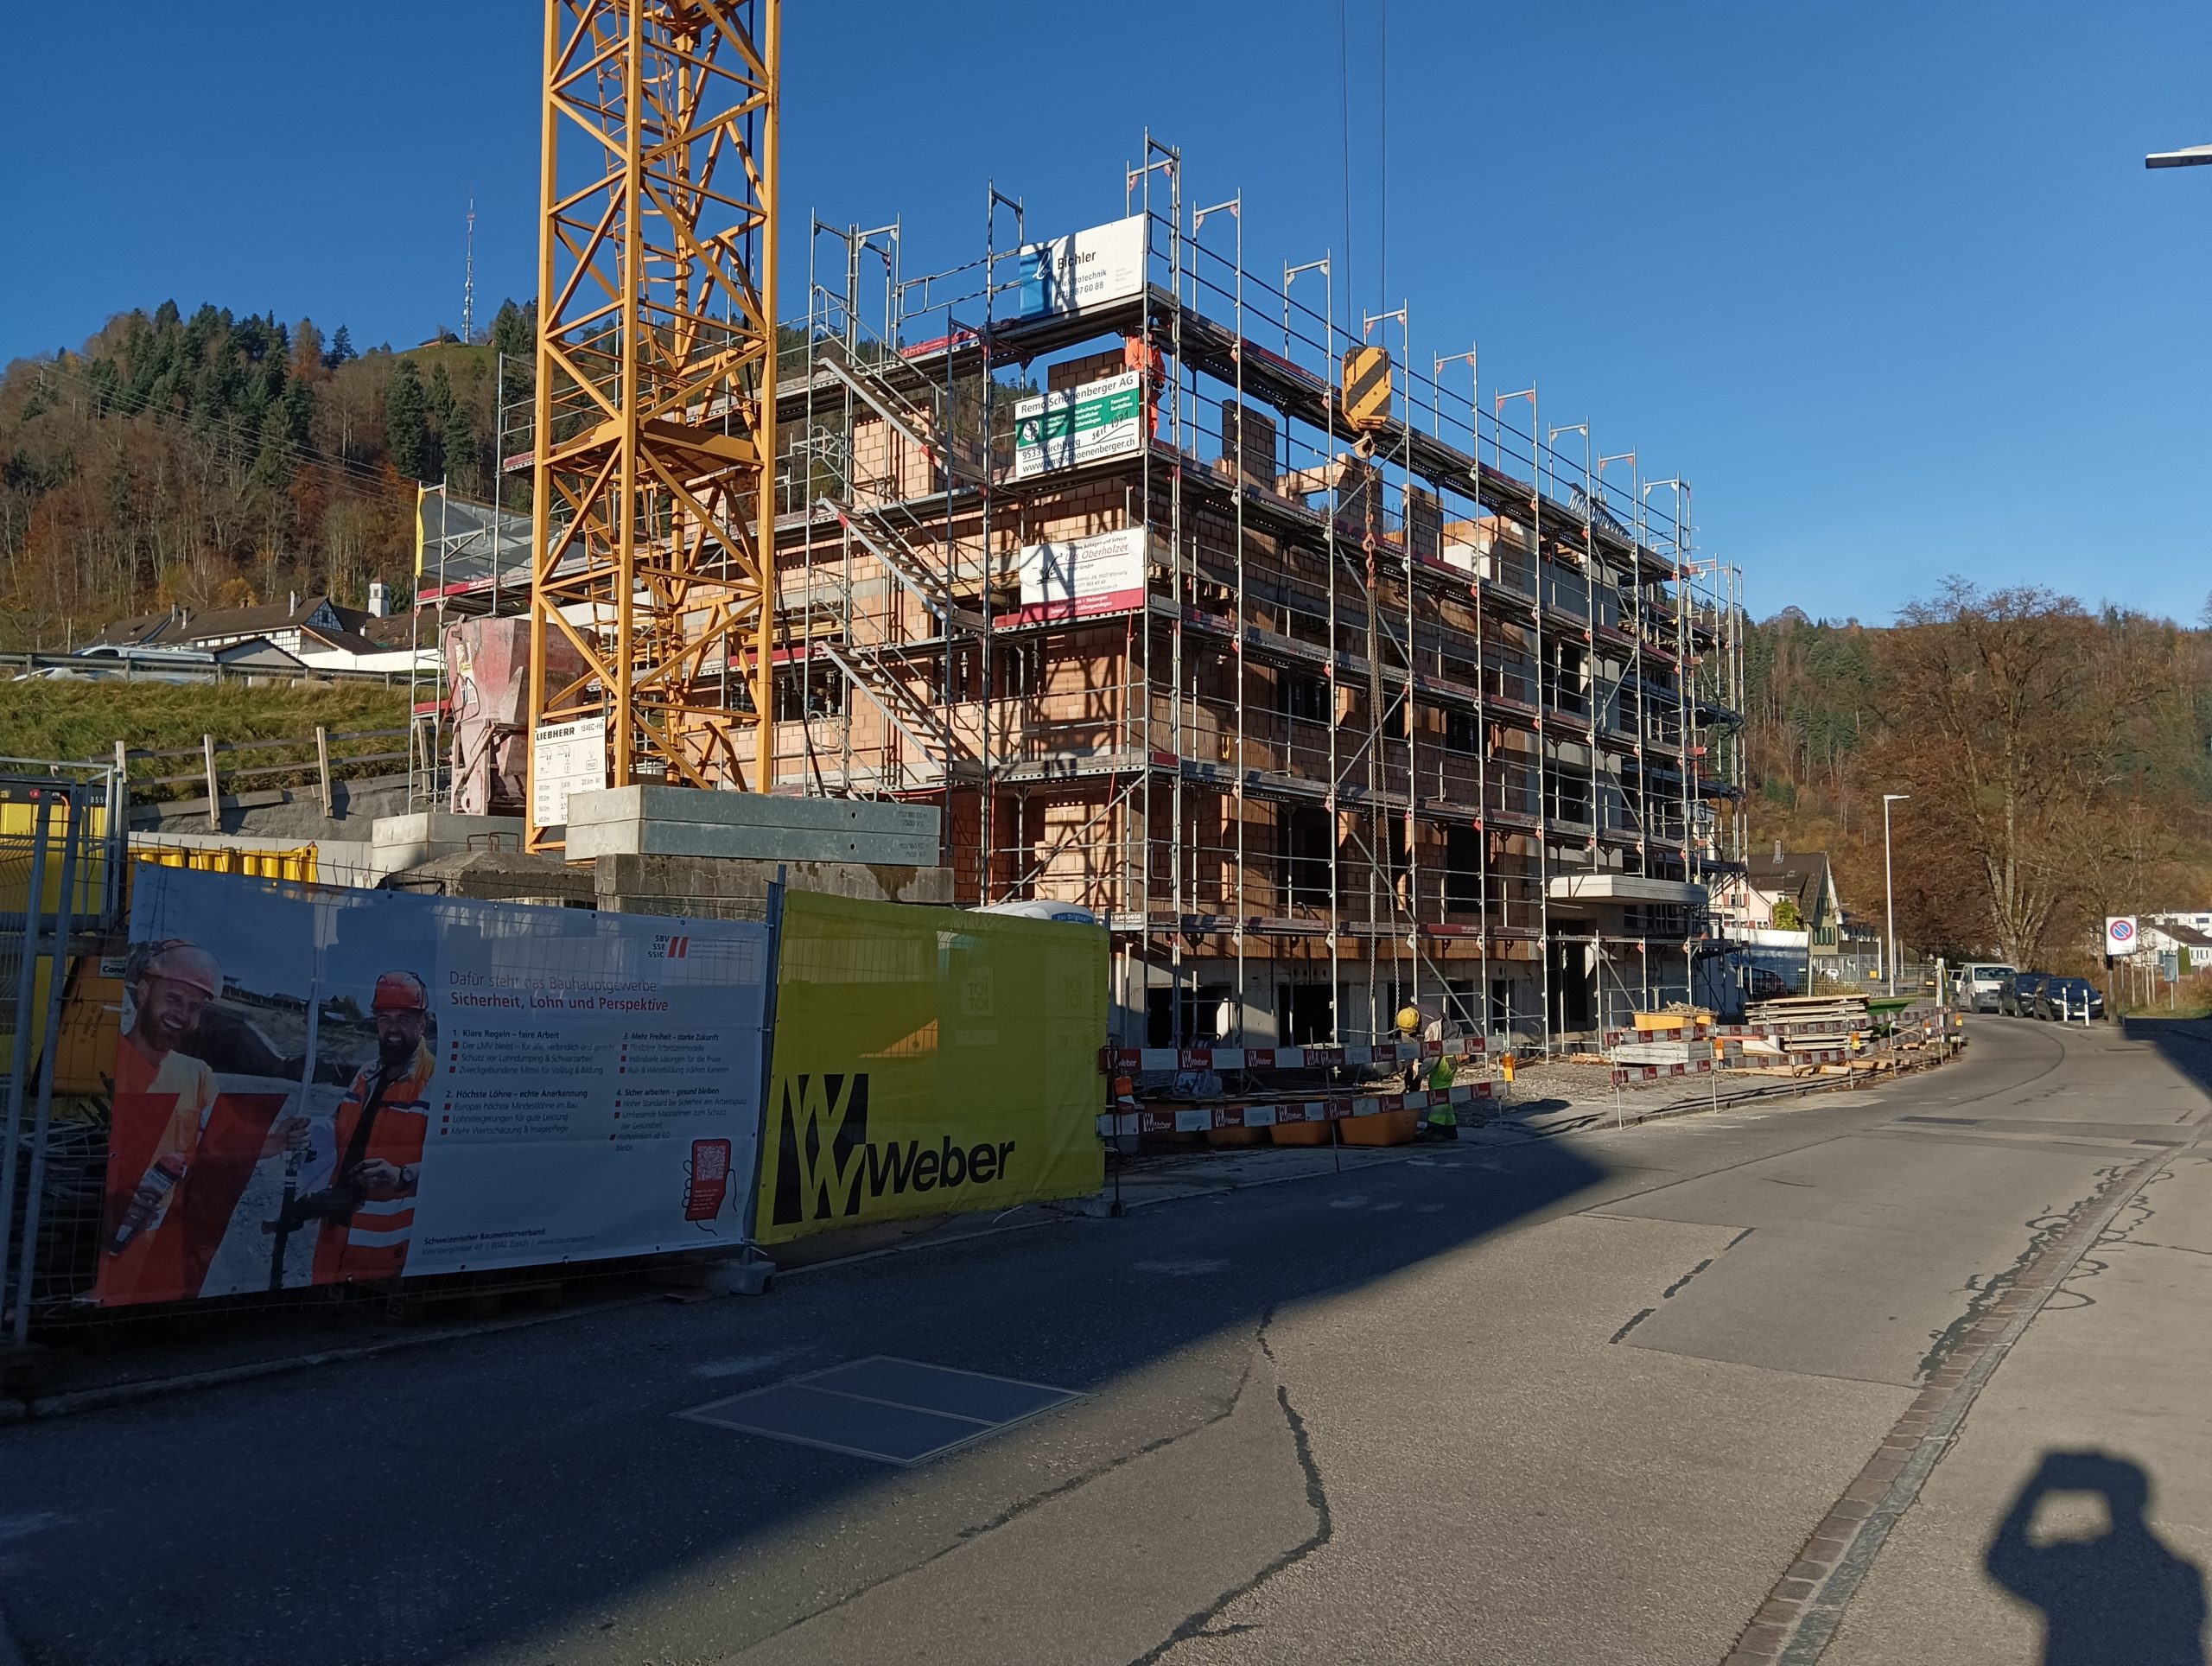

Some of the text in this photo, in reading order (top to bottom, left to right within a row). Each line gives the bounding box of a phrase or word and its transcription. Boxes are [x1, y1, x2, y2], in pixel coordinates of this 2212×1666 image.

[1058, 251, 1096, 270] Bichler
[1058, 269, 1107, 289] Elektrotechnik
[1021, 375, 1134, 414] Remo Schönenberger AG
[1091, 410, 1129, 441] seit 1971
[1022, 438, 1081, 461] 9533 Kirchberg
[1022, 436, 1135, 473] www.remo-schoenenberger.ch
[1081, 543, 1129, 561] Oberholzer
[536, 727, 575, 741] LIEBHERR
[450, 971, 658, 993] Dafür steht das Bauhauptgewerbe:
[451, 992, 668, 1013] Sicherheit, Lohn und Perspektive
[485, 1030, 510, 1040] Regeln
[499, 1055, 543, 1064] Lohndumping
[459, 1066, 518, 1075] Zweckgebundene
[551, 1067, 573, 1076] Vollzug
[581, 1067, 603, 1076] Bildung
[647, 1066, 683, 1075] Weiterbildung
[541, 1091, 588, 1099] Anerkennung
[455, 1103, 481, 1111] Europas
[453, 1115, 512, 1124] Lohnsteigerungen
[526, 1115, 540, 1123] gute
[543, 1114, 568, 1123] Leistung
[472, 1126, 523, 1136] Wertschätzung
[531, 1125, 569, 1135] Imagepflege
[866, 1135, 1015, 1198] Weber
[424, 1228, 545, 1244] Schweizerischer Baumeisterverband
